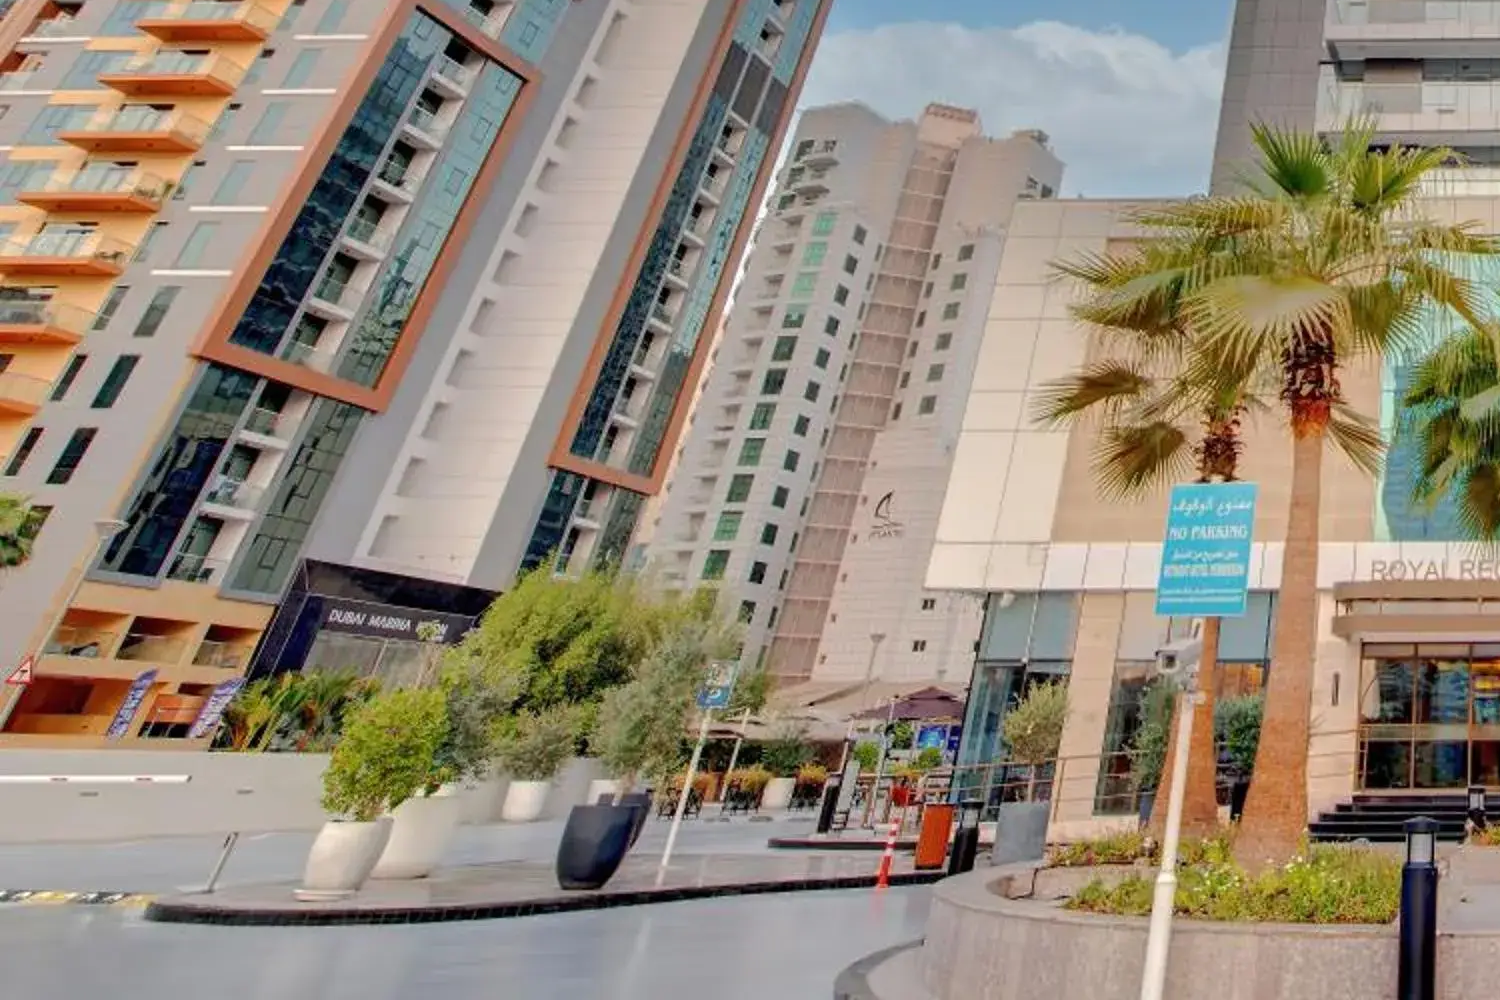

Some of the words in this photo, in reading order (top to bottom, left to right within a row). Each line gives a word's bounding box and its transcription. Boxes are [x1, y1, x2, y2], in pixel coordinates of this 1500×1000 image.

[1169, 527, 1188, 540] NO
[1190, 524, 1248, 540] PARKING
[1370, 560, 1447, 581] ROYAL
[328, 609, 367, 625] DUBAI
[366, 615, 411, 632] MARINA
